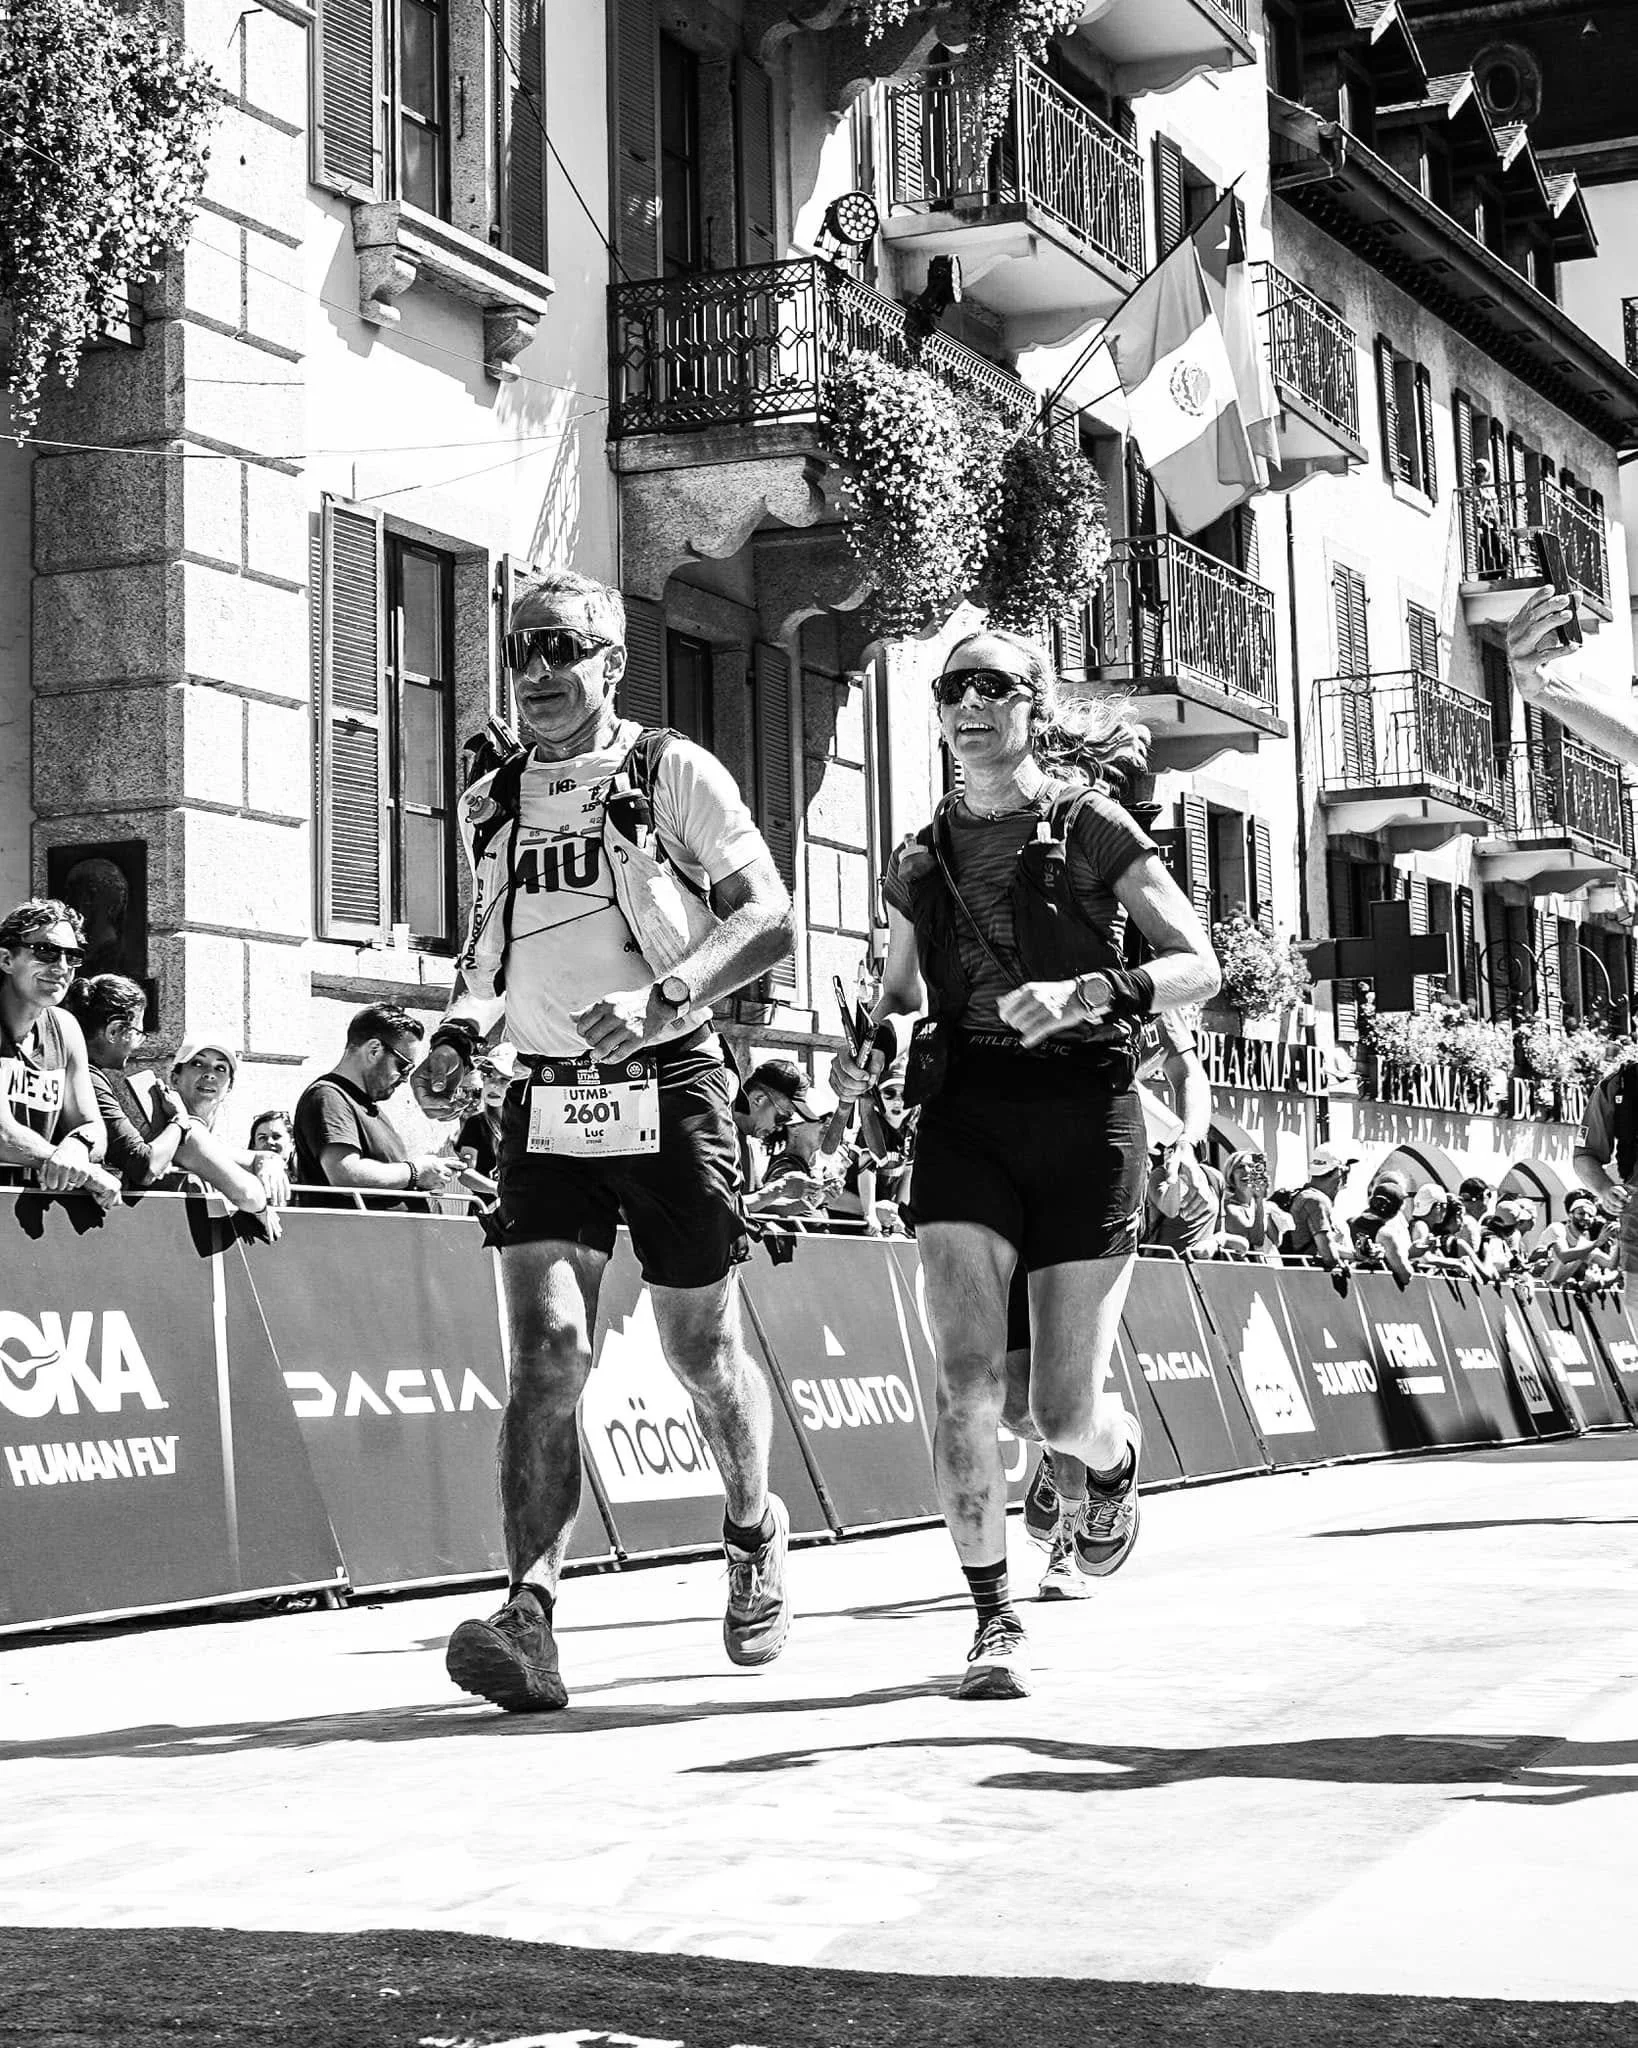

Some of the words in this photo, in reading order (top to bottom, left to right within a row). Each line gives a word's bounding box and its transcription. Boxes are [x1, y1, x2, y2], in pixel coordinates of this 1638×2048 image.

[569, 1087, 608, 1101] UTMB
[564, 1101, 621, 1124] 2601
[585, 1128, 604, 1138] Luc
[1137, 1351, 1210, 1382] DACIA
[282, 1367, 503, 1418] DACIA
[791, 1374, 915, 1431] SUUNTO
[4, 1439, 133, 1487] HUMAN
[126, 1435, 180, 1477] FLY
